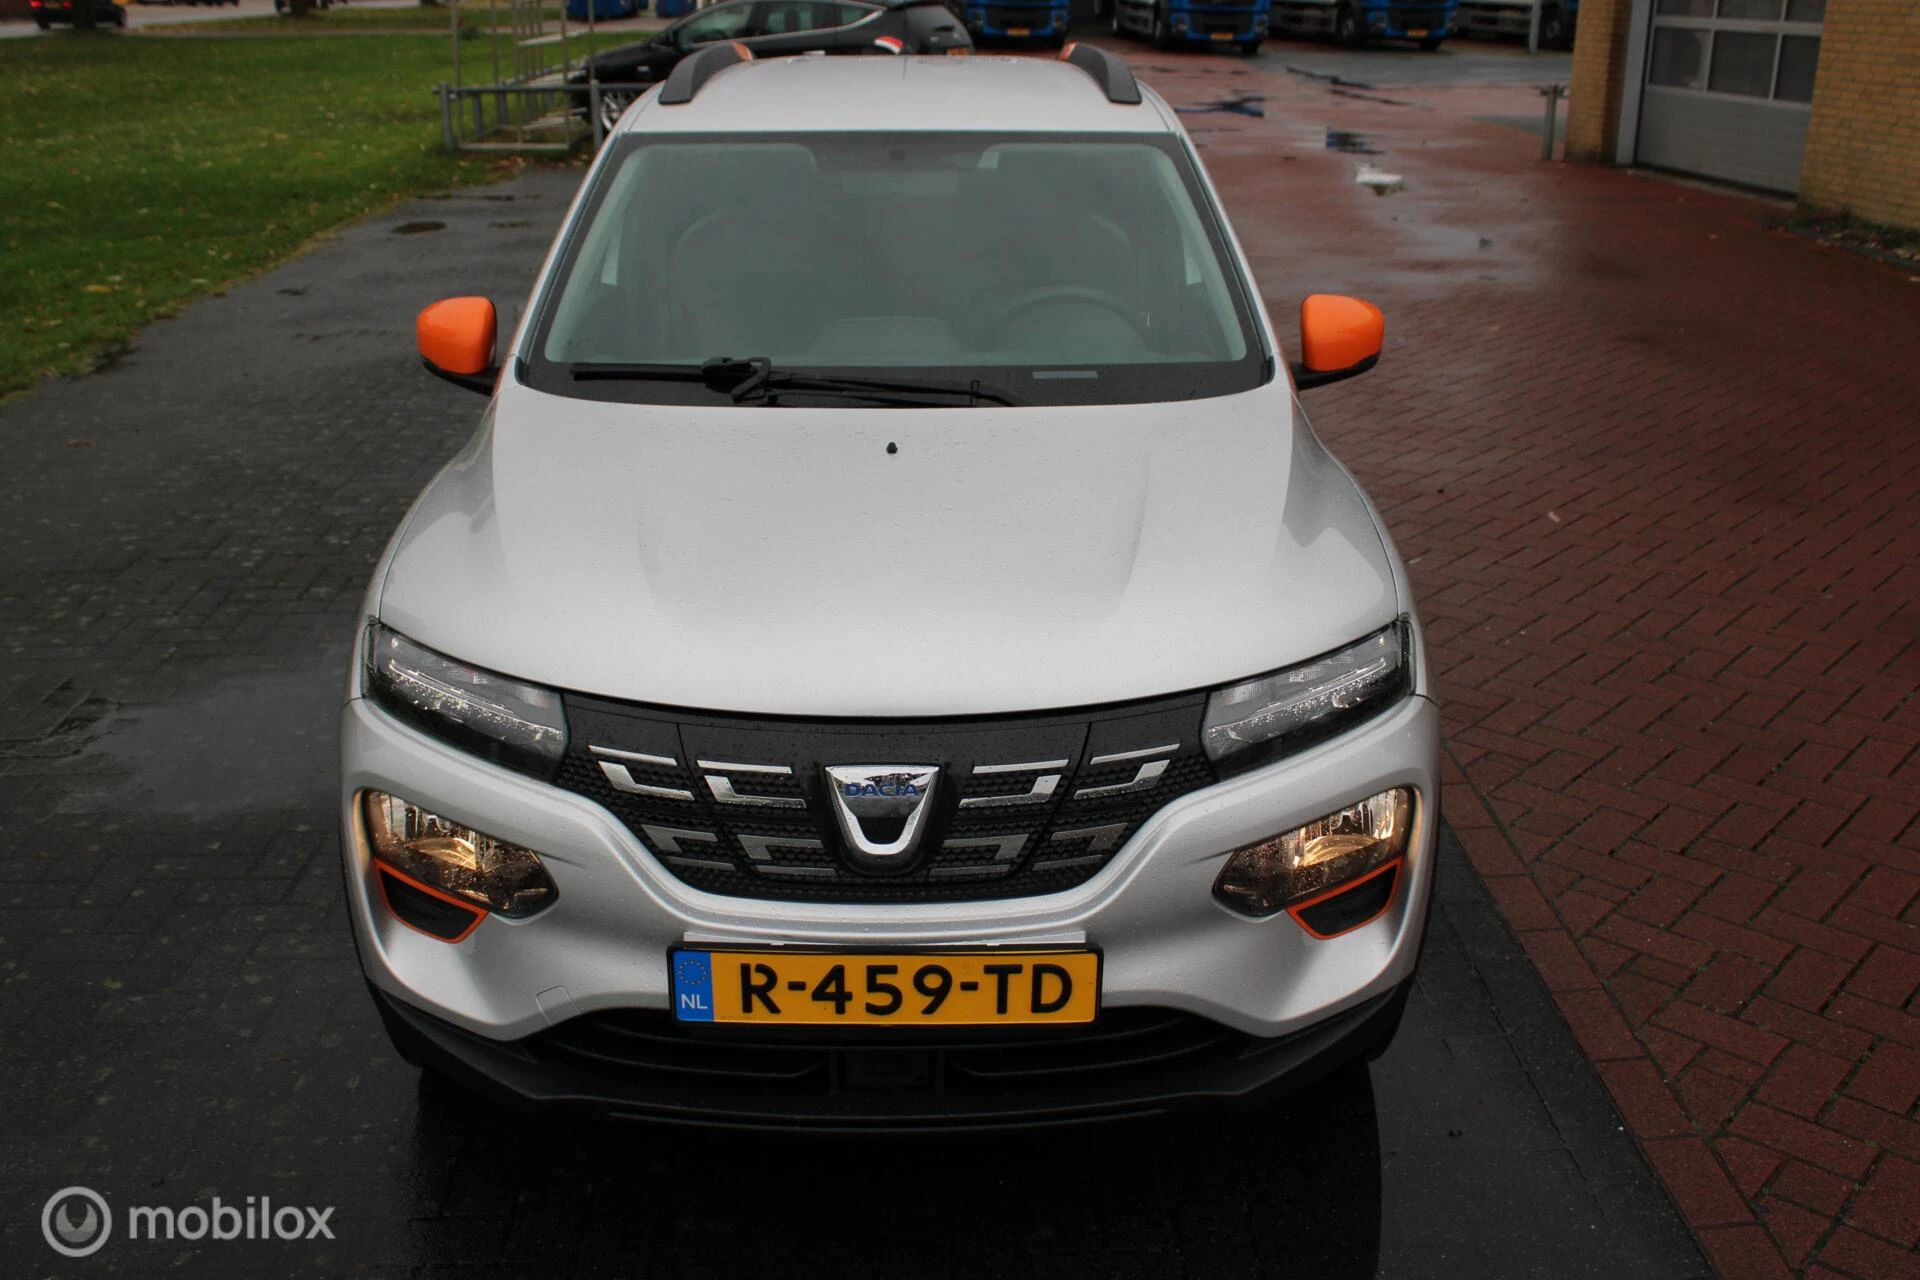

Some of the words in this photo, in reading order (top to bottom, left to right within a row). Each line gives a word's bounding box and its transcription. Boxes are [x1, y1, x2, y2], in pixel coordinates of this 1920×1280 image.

[845, 782, 919, 797] DACIA
[740, 963, 1073, 1016] R-459-TD
[681, 993, 708, 1010] NL
